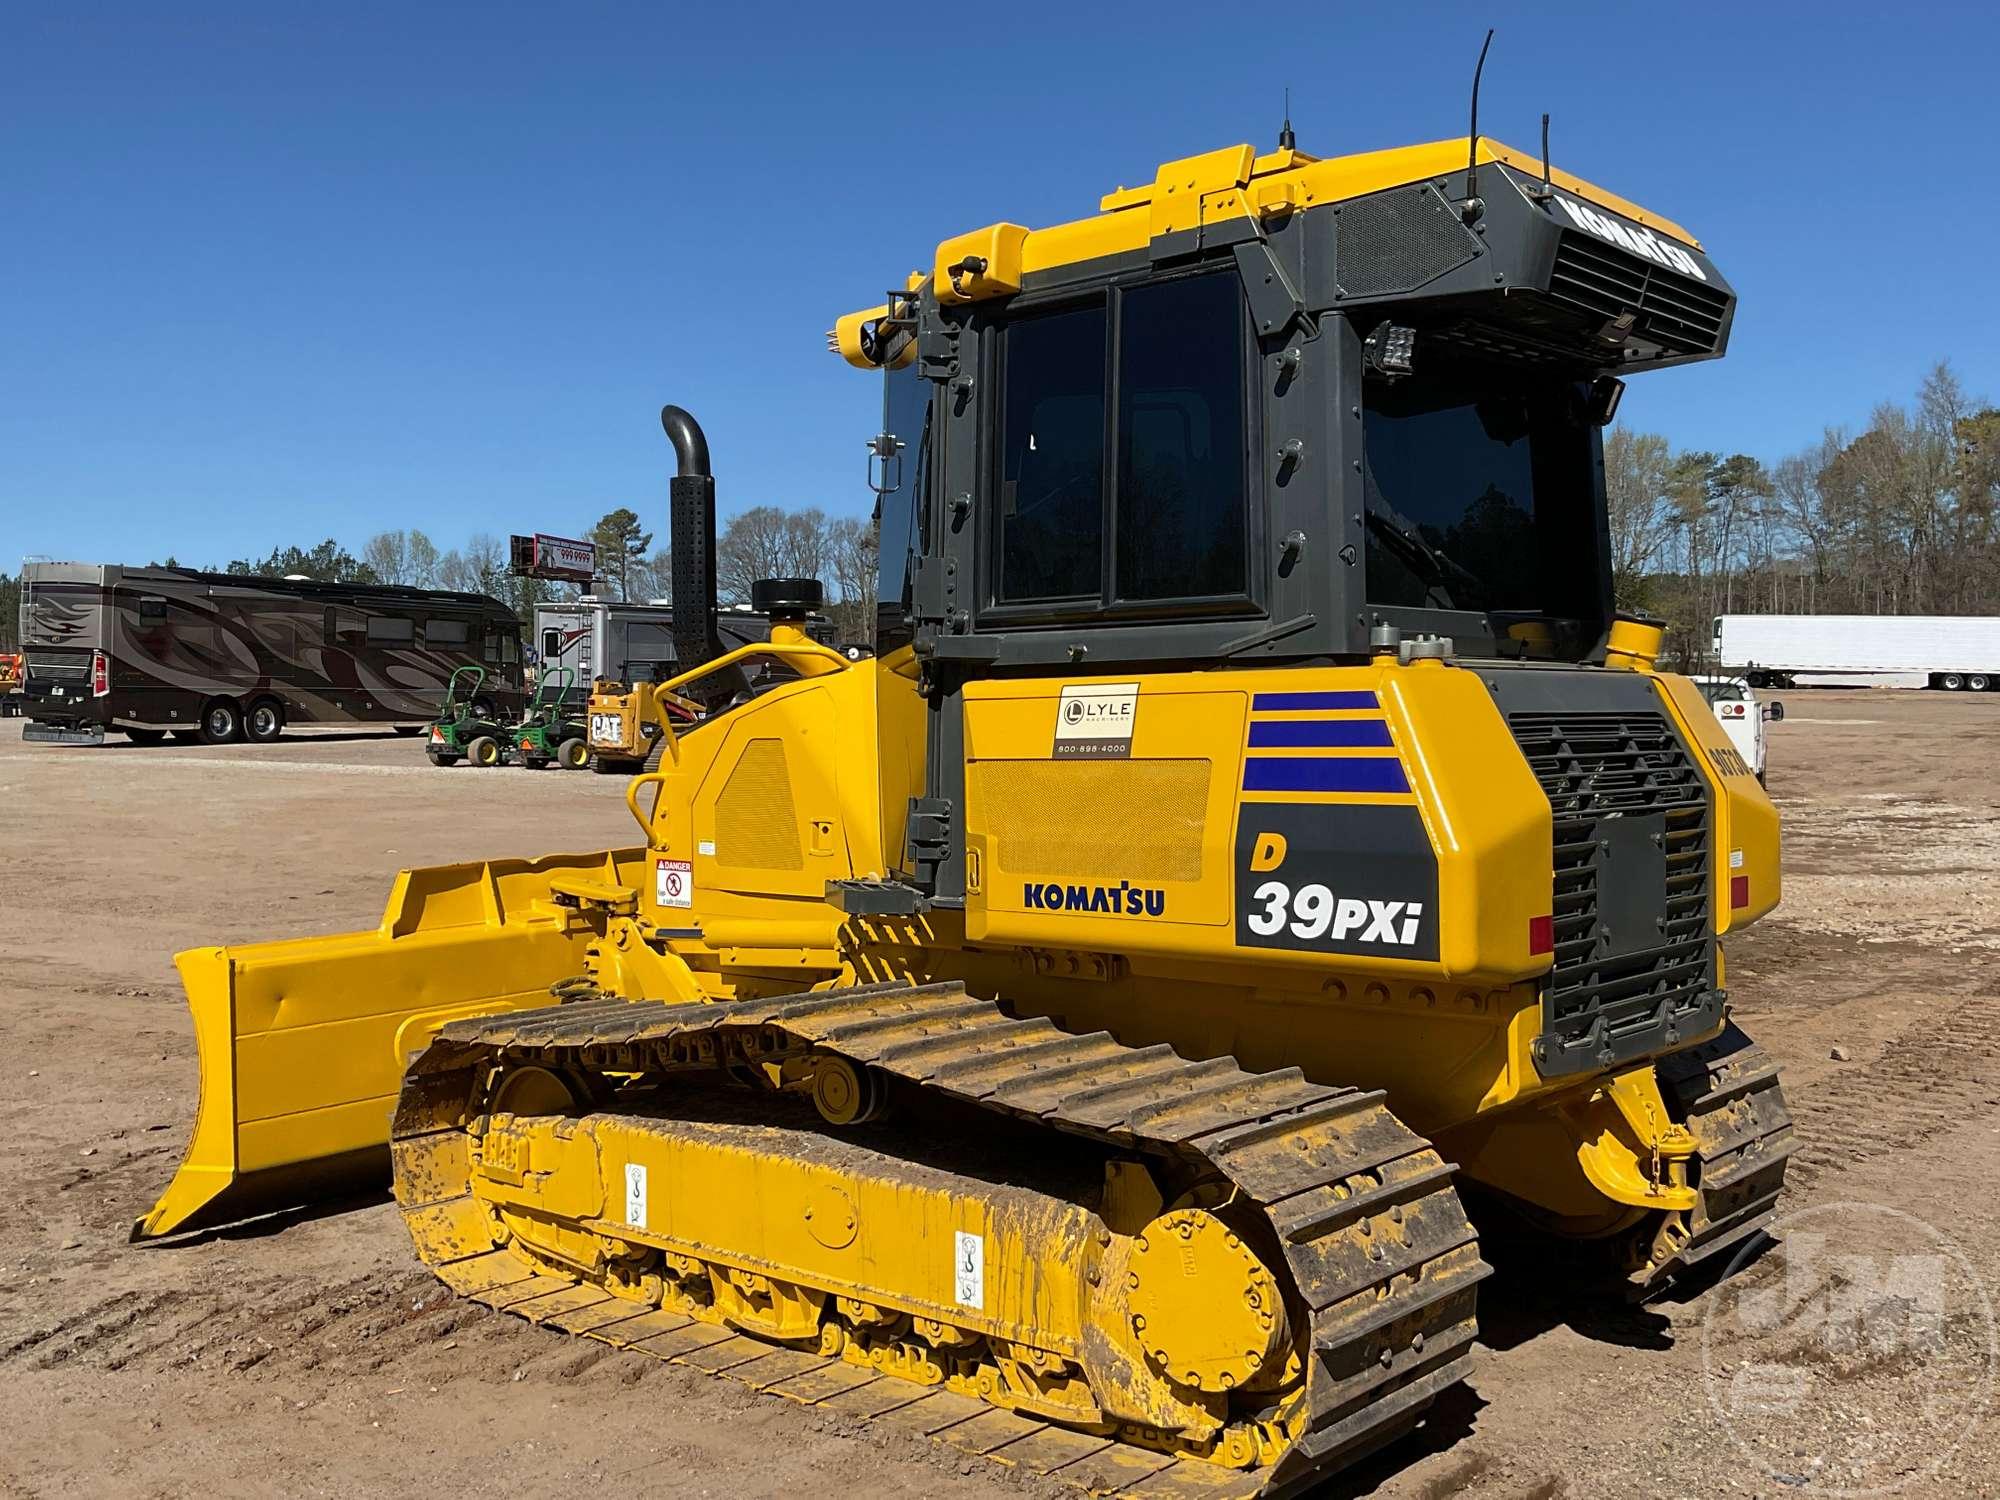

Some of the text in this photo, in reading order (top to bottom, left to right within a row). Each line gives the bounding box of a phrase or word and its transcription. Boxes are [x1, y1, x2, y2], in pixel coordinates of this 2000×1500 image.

[1553, 194, 1707, 281] KOMATSU
[1087, 703, 1131, 716] LYLE
[592, 716, 621, 741] CAT
[664, 861, 691, 871] DANGER
[1250, 832, 1288, 872] D
[1024, 880, 1165, 917] KOMATSU
[1248, 881, 1423, 945] 39PXi
